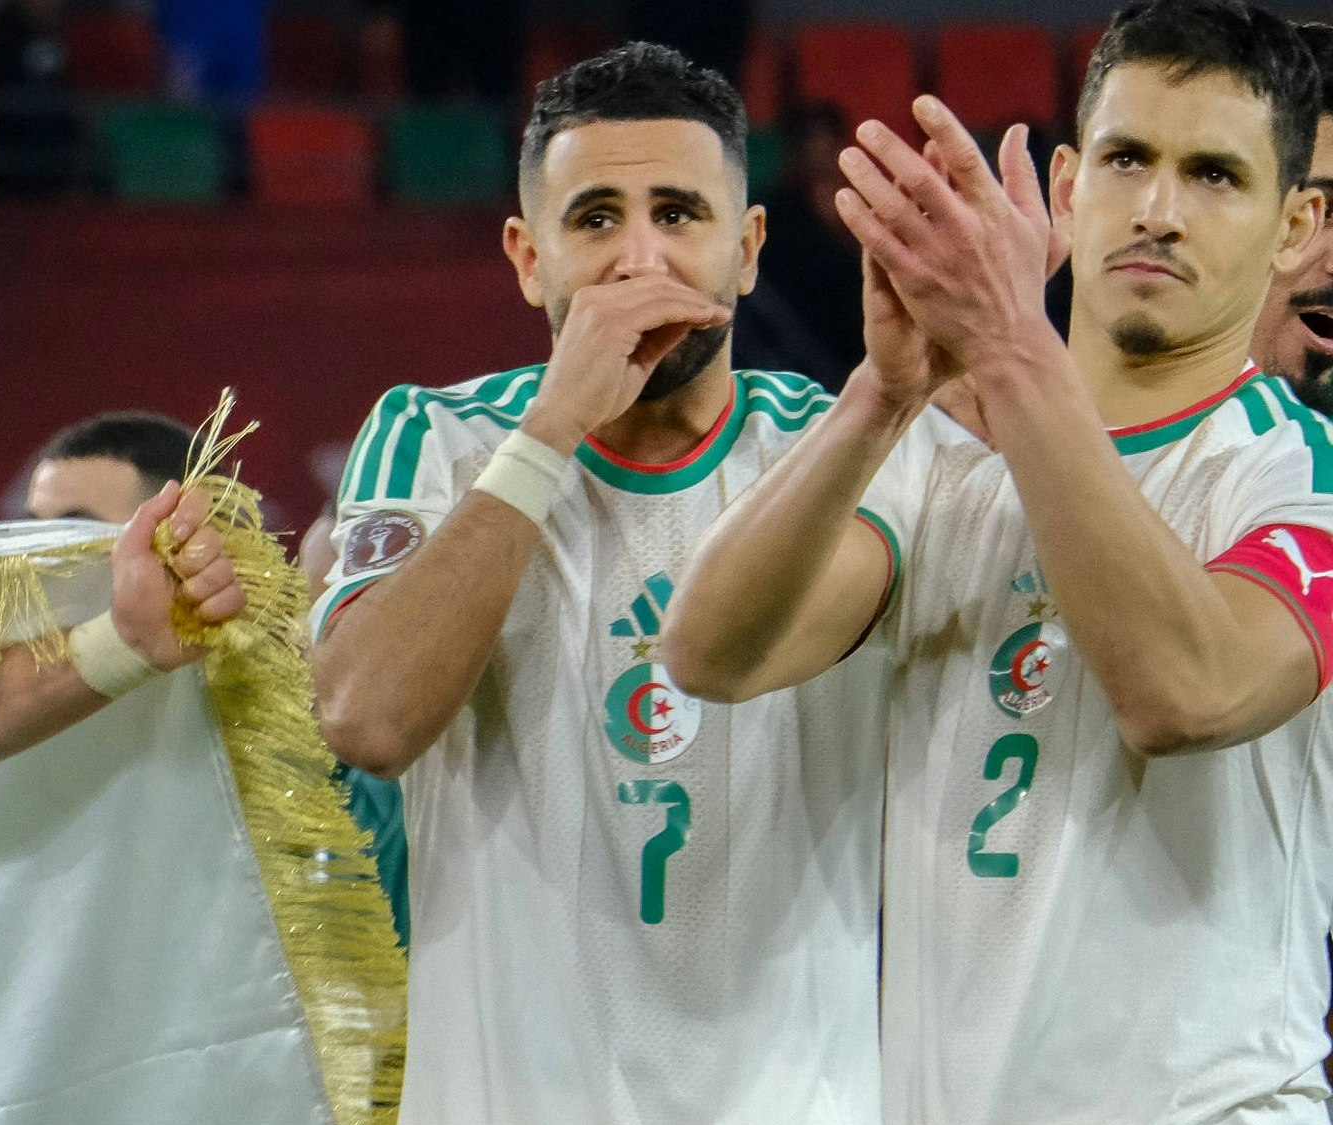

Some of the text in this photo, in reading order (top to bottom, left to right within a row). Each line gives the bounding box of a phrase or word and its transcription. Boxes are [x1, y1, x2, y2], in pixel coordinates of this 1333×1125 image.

[620, 733, 684, 754] ALGERIA
[967, 732, 1038, 878] 2
[617, 779, 691, 926] 7
